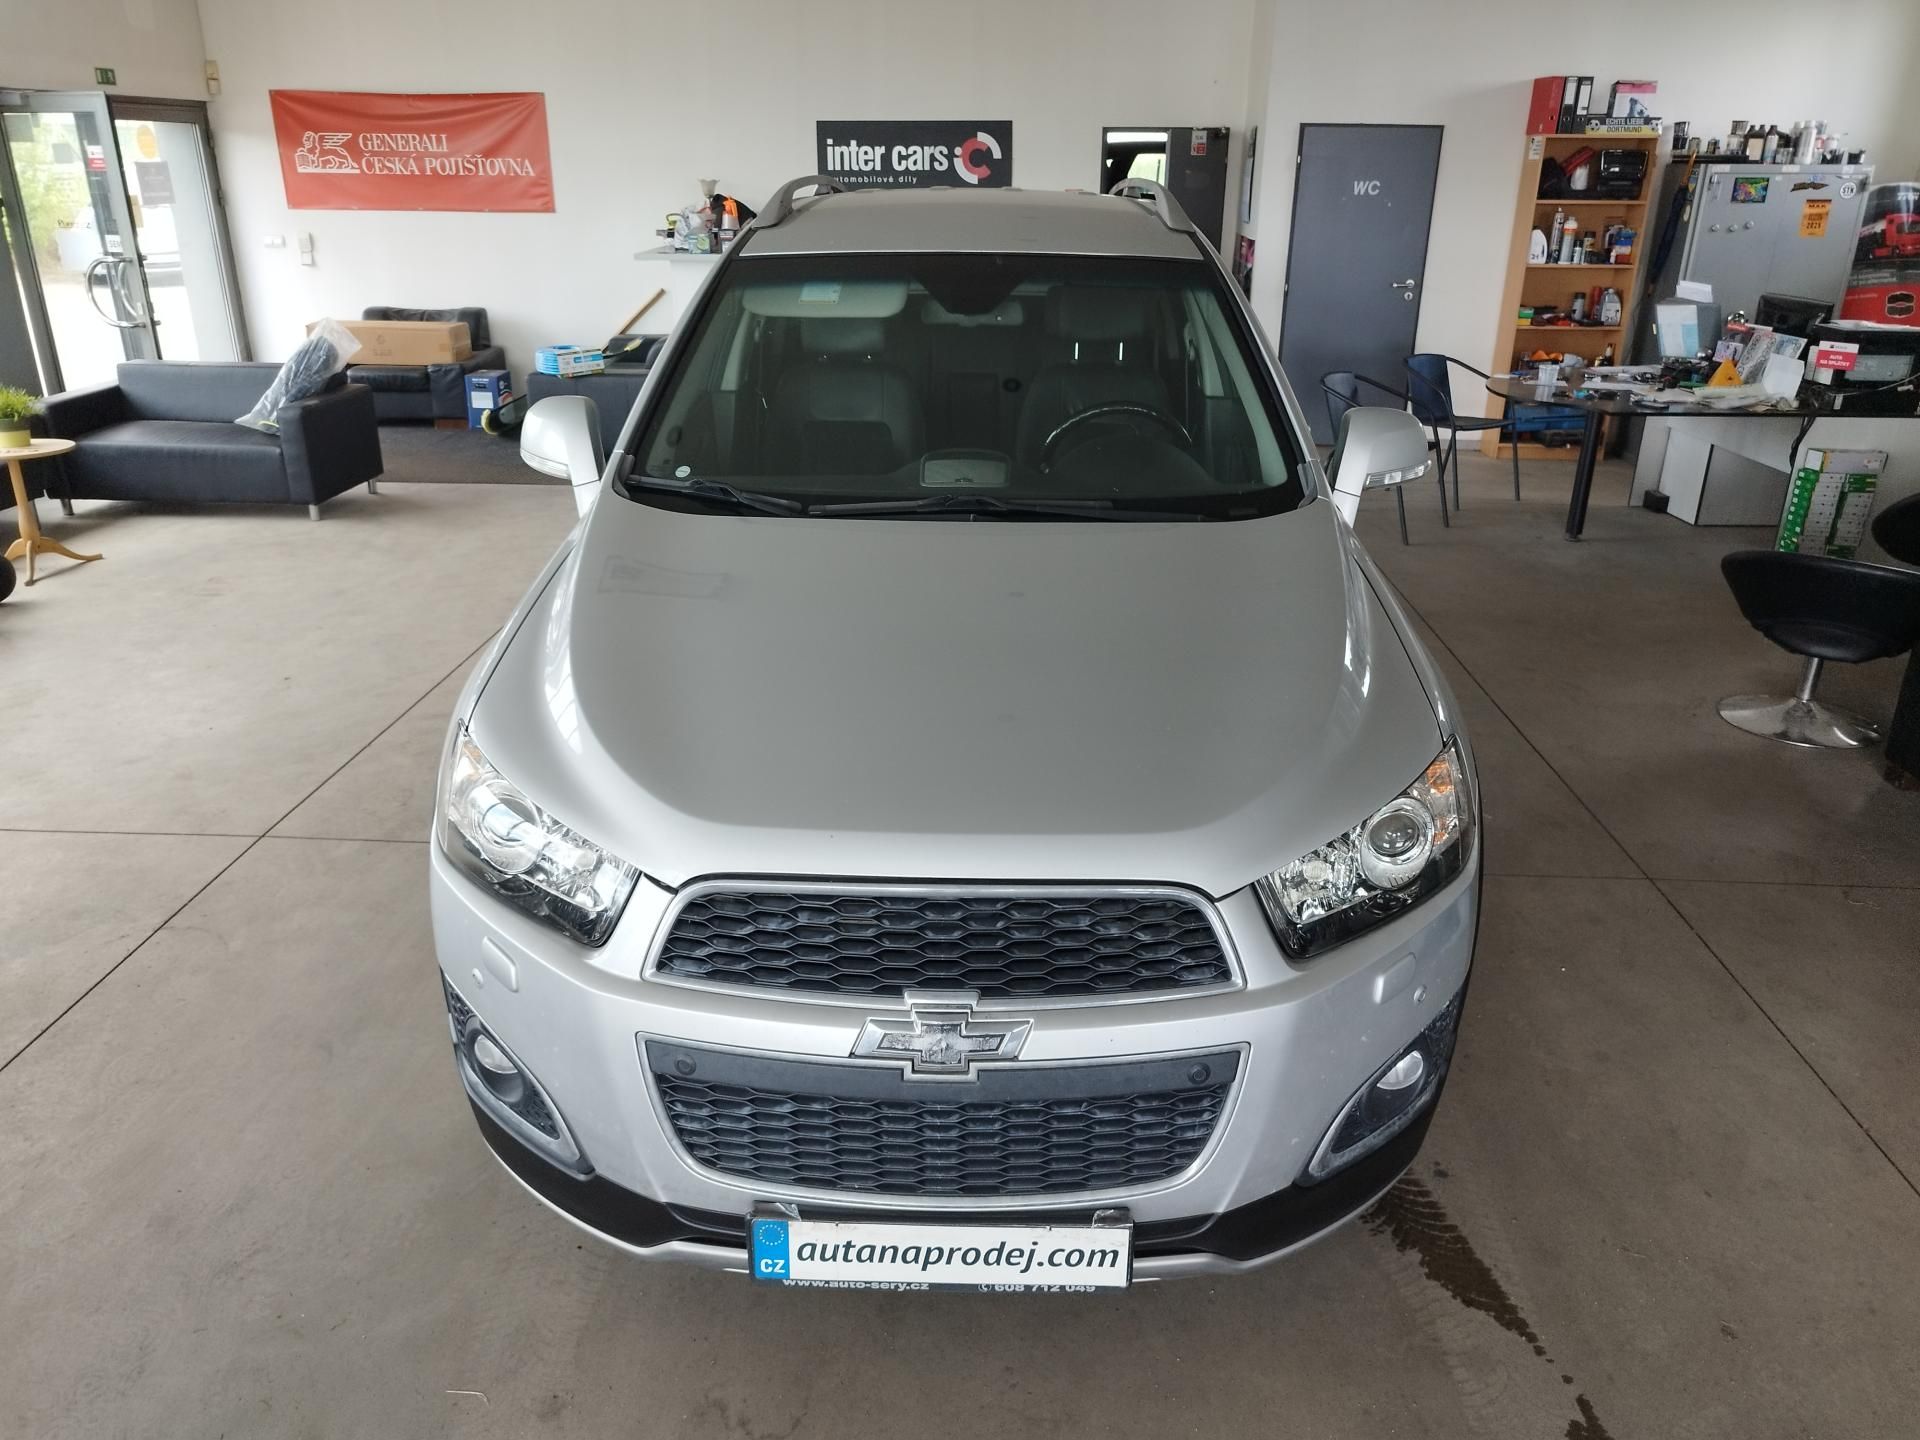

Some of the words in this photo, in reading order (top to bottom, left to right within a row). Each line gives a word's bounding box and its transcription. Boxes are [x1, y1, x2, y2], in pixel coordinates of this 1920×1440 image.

[359, 132, 448, 152] GENERALI
[361, 153, 421, 175] ČESKÁ
[424, 154, 535, 177] POJIŠŤOVNA
[826, 138, 886, 171] inter
[891, 144, 949, 172] cars
[836, 175, 894, 183] tomobilové
[1353, 180, 1381, 196] WC
[759, 1257, 786, 1274] CZ
[796, 1238, 1120, 1274] autanaprodej.com
